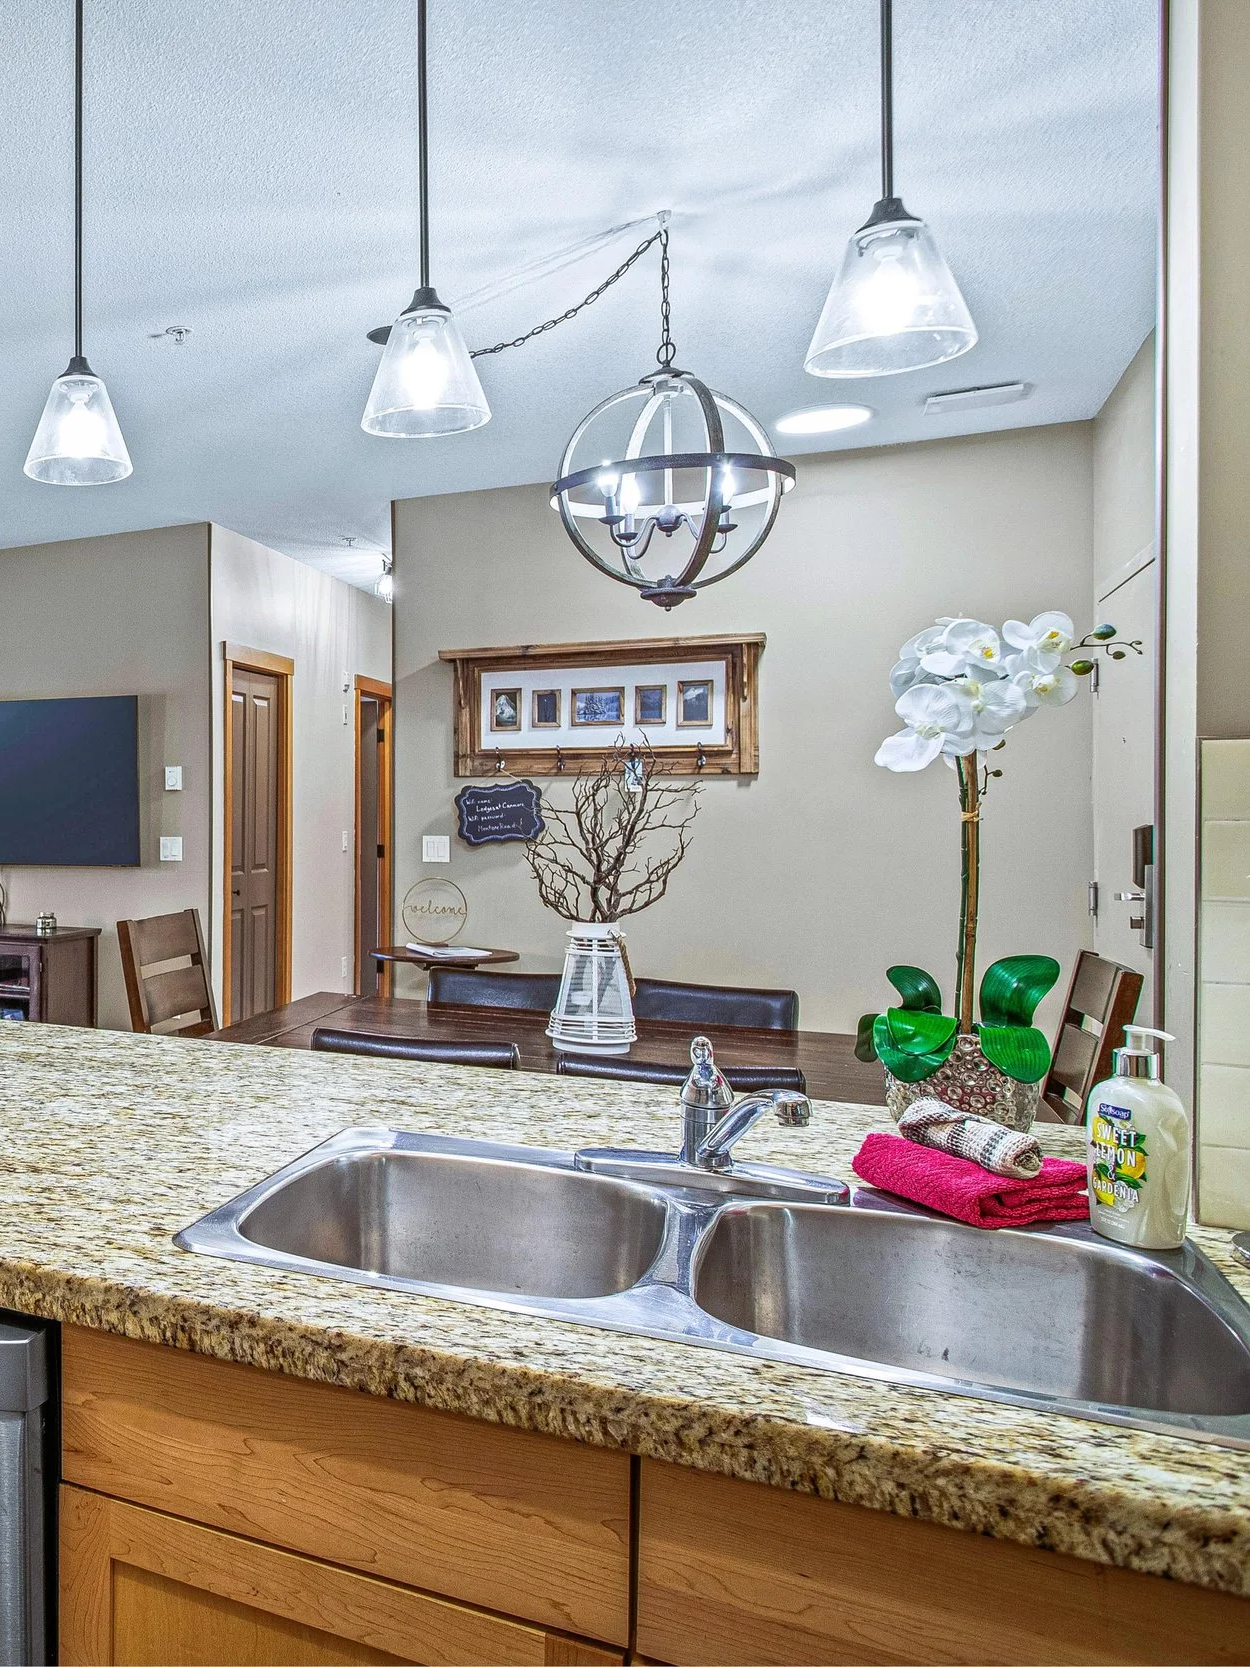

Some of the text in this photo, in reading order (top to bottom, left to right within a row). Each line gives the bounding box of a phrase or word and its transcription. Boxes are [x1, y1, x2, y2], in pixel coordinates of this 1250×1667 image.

[404, 900, 466, 916] welcome
[1100, 1104, 1130, 1119] Softsoap
[1096, 1122, 1137, 1148] SWEET
[1095, 1141, 1136, 1168] LEMON
[1107, 1164, 1116, 1181] &
[1092, 1177, 1139, 1203] GARDENIA
